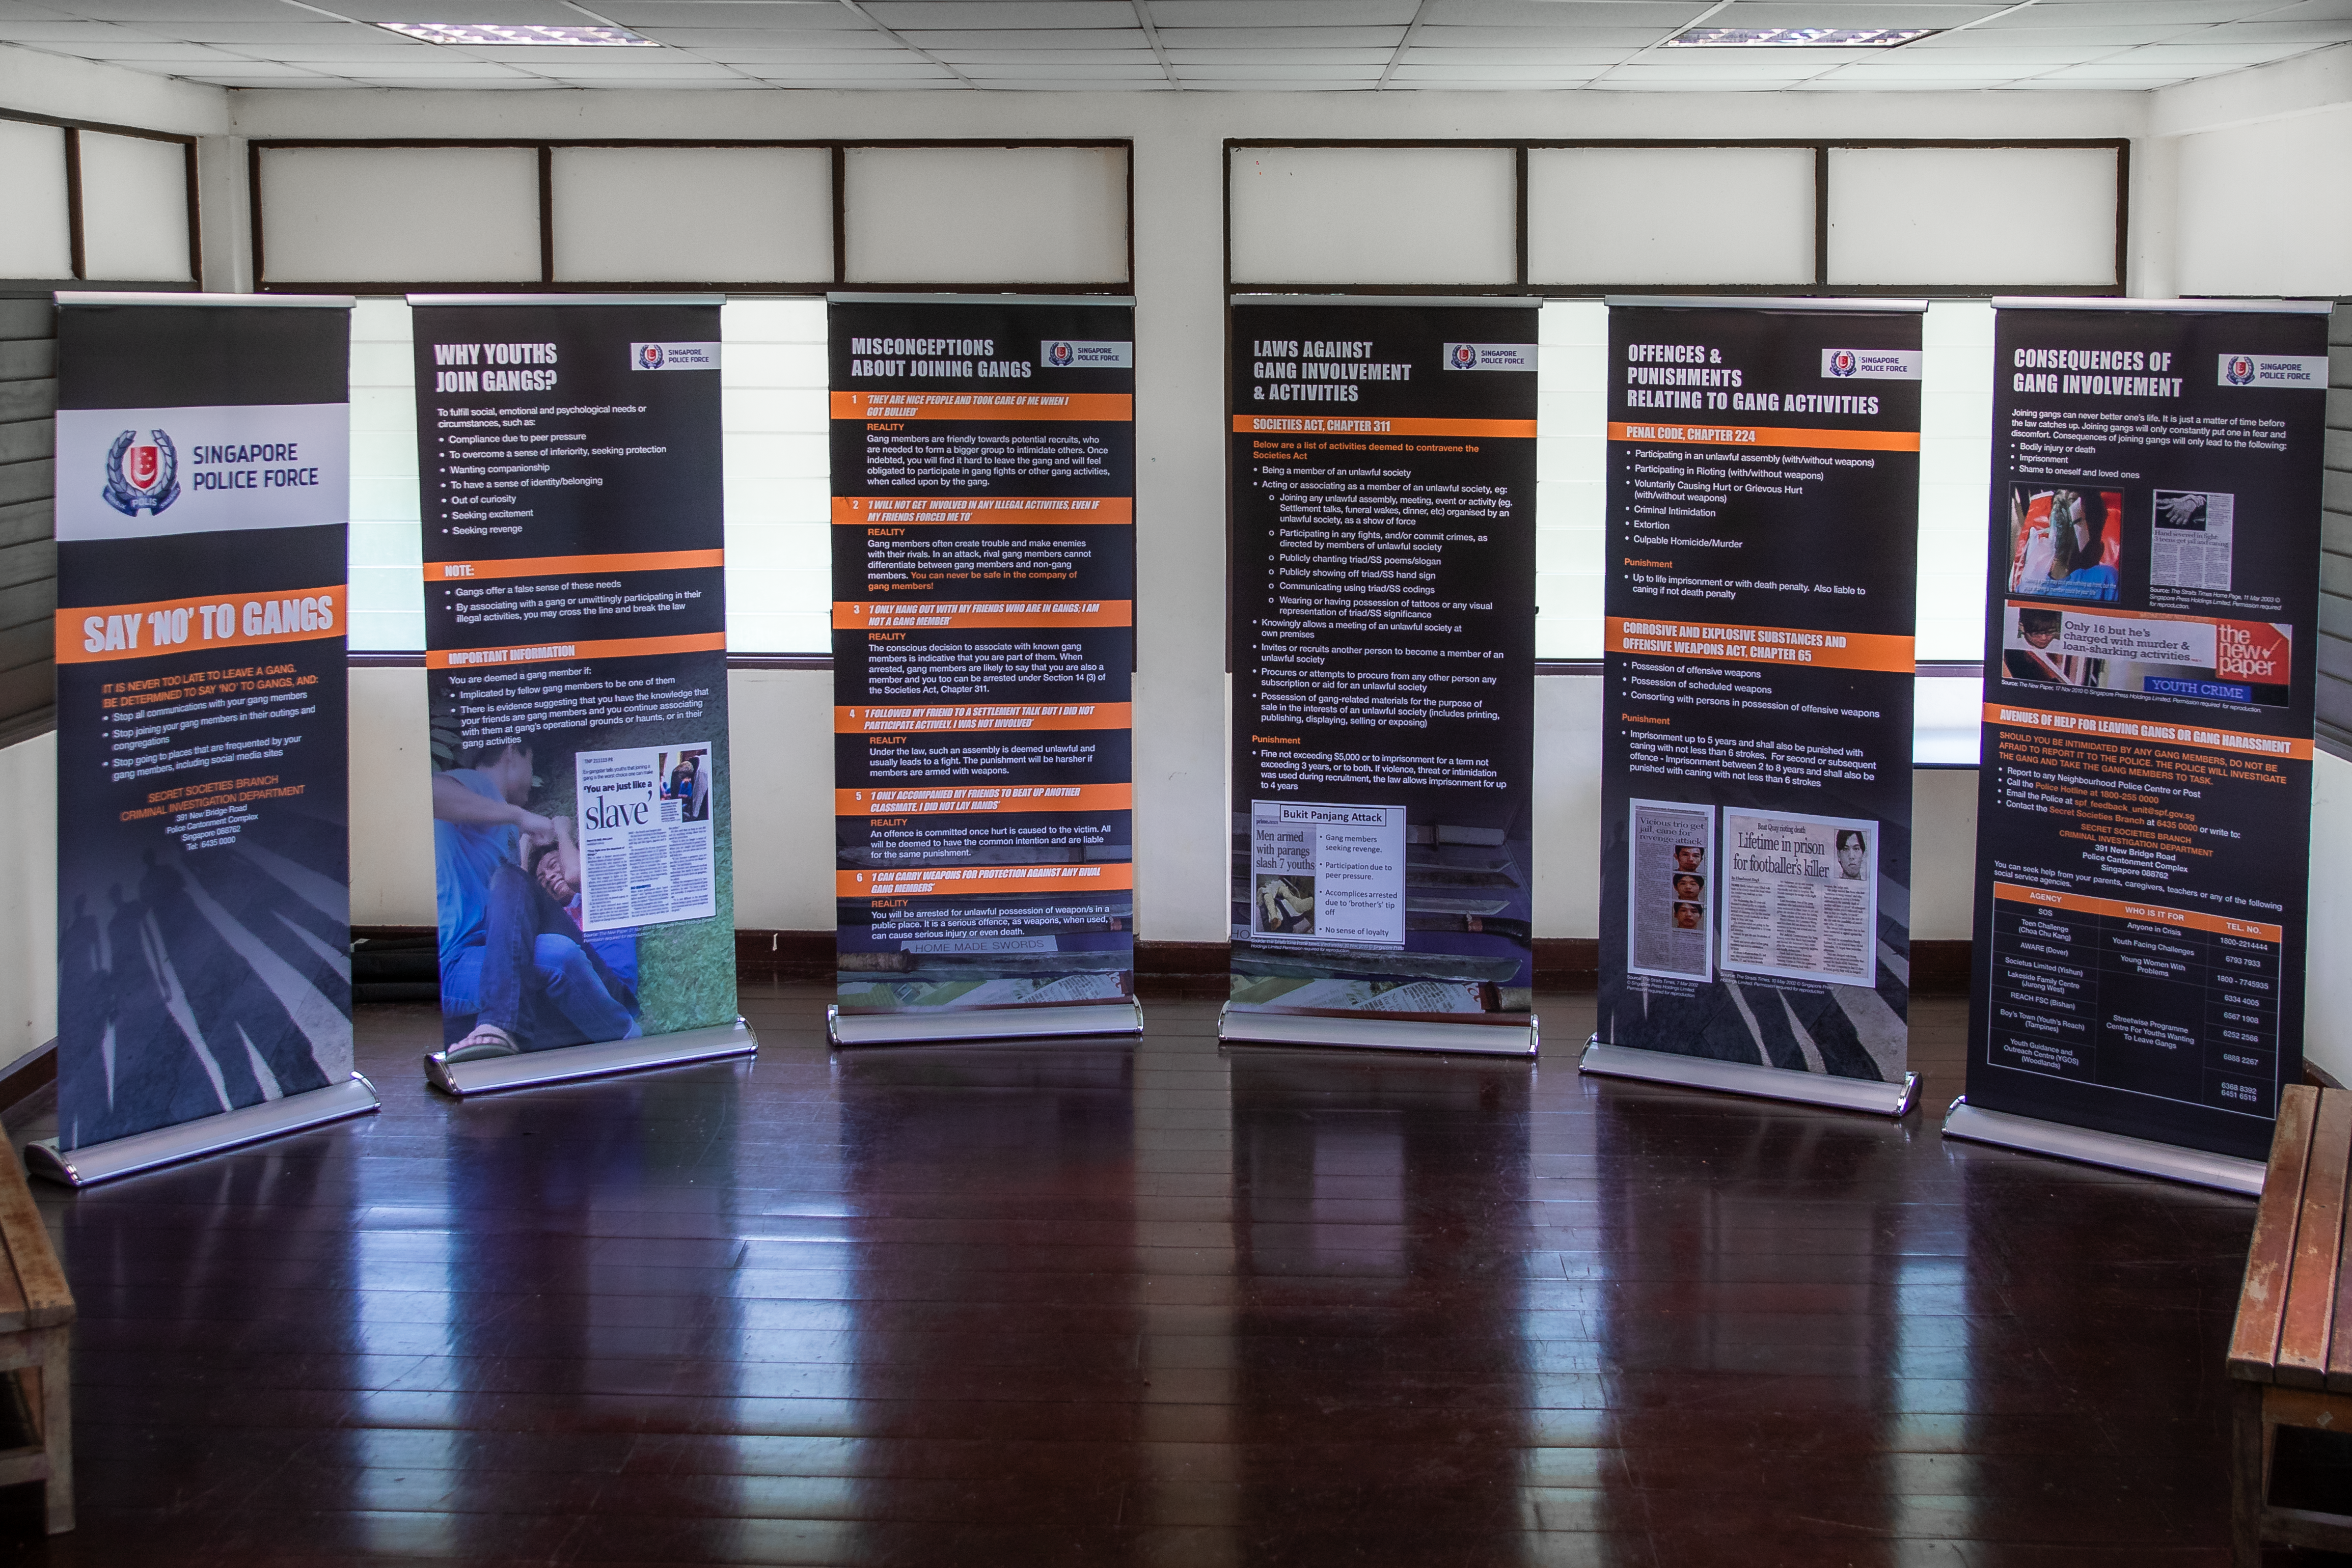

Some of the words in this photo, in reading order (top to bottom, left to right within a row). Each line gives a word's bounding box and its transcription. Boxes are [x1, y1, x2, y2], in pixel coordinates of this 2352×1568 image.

[852, 338, 993, 355] MISCONCEPTIONS
[1254, 341, 1298, 356] LAWS
[1303, 341, 1373, 357] AGAINST
[434, 344, 480, 365] WHY
[483, 344, 557, 364] YOUTHS
[1629, 345, 1704, 363] OFFENCES
[1710, 349, 1721, 363] &
[2014, 349, 2143, 370] CONSEQUENCES
[2149, 352, 2171, 371] OF
[852, 360, 905, 376] ABOUT
[910, 361, 972, 376] JOINING
[978, 361, 1031, 377] GANGS
[1254, 362, 1296, 378] GANG
[1302, 363, 1411, 380] INVOLVEMENT
[436, 371, 478, 392] JOIN
[481, 370, 557, 391] GANGS?
[1628, 368, 1741, 386] PUNISHMENTS
[2013, 373, 2057, 392] GANG
[2063, 375, 2182, 396] INVOLVEMENT
[1254, 386, 1264, 399] &
[1269, 384, 1358, 401] ACTIVITIES
[1628, 390, 1701, 408] RELATING
[1707, 392, 1727, 409] TO
[1733, 393, 1779, 410] GANG
[1784, 395, 1878, 414] ACTIVITIES
[1253, 419, 1302, 430] SOCIETIES
[1304, 420, 1325, 431] ACT,
[1327, 420, 1371, 431] CHAPTER
[1374, 421, 1390, 431] 311
[1627, 426, 1655, 438] PENAL
[1657, 427, 1685, 440] CODE,
[1687, 428, 1733, 441] CHAPTER
[1735, 430, 1755, 442] 224
[194, 444, 297, 464] SINGAPORE
[2020, 443, 2042, 452] Bodily
[2044, 444, 2064, 453] injury
[2020, 454, 2068, 463] Imprisonment
[449, 466, 485, 475] Wanting
[487, 463, 550, 473] companionship
[194, 471, 257, 490] POLICE
[264, 468, 318, 487] FORCE
[941, 478, 950, 486] by
[132, 498, 157, 507] POLIS
[451, 496, 468, 504] Out
[480, 495, 516, 504] curiosity
[451, 511, 486, 520] Seeking
[489, 510, 533, 518] excitement
[1634, 505, 1666, 514] Criminal
[1669, 507, 1715, 516] Intimidation
[1634, 520, 1670, 529] Extortion
[1634, 535, 1668, 544] Culpable
[1671, 537, 1742, 547] Homicide/Murder
[1625, 558, 1672, 568] Punishment
[445, 565, 474, 576] NOTE:
[1280, 568, 1310, 577] Publicly
[1313, 569, 1346, 578] showing
[1419, 571, 1435, 581] sign
[84, 614, 142, 652] SAY
[200, 604, 235, 639] TO
[243, 596, 333, 635] GANGS
[2065, 621, 2090, 633] Only
[2094, 624, 2105, 633] 16
[2108, 626, 2125, 635] but
[2219, 625, 2250, 644] the
[449, 650, 508, 664] IMPORTANT
[510, 645, 575, 660] INFORMATION
[2220, 642, 2261, 659] new
[2219, 656, 2276, 677] paper
[941, 685, 973, 694] Chapter
[2152, 680, 2197, 693] YOUTH
[2201, 684, 2243, 698] CRIME
[112, 713, 133, 721] Stop
[135, 710, 145, 719] all
[147, 703, 207, 717] communications
[227, 698, 245, 707] your
[246, 696, 268, 705] gang
[270, 692, 307, 701] members
[112, 737, 169, 750] congregations
[461, 740, 483, 749] gang
[486, 736, 521, 747] activities
[1252, 735, 1300, 744] Punishment
[148, 788, 183, 802] SECRET
[186, 781, 233, 795] SOCIETIES
[236, 776, 278, 788] BRANCH
[616, 782, 631, 791] just
[647, 781, 652, 790] a
[1283, 810, 1308, 819] Bukit
[1311, 811, 1349, 822] Panjang
[1352, 813, 1382, 821] Attack
[200, 839, 217, 847] 6435
[218, 836, 235, 844] 0000
[1256, 830, 1274, 842] Men
[1277, 831, 1303, 842] armed
[1256, 843, 1274, 856] with
[1277, 848, 1309, 858] parangs
[1738, 832, 1779, 850] Lifetime
[1781, 835, 1791, 851] in
[1793, 838, 1824, 856] prison
[1256, 858, 1277, 868] slash
[1279, 858, 1284, 868] 7
[1287, 859, 1315, 870] youths
[1733, 853, 1747, 870] for
[1803, 859, 1829, 877] killer
[2030, 892, 2062, 902] AGENCY
[2125, 906, 2145, 915] WHO
[2168, 913, 2184, 921] FOR
[2127, 922, 2153, 931] Anyone
[2163, 927, 2181, 936] Crisis
[2226, 922, 2244, 931] TEL.
[915, 944, 950, 953] HOME
[954, 943, 988, 951] MADE
[993, 940, 1044, 949] SWORDS
[2221, 938, 2267, 950] 1800-2214444
